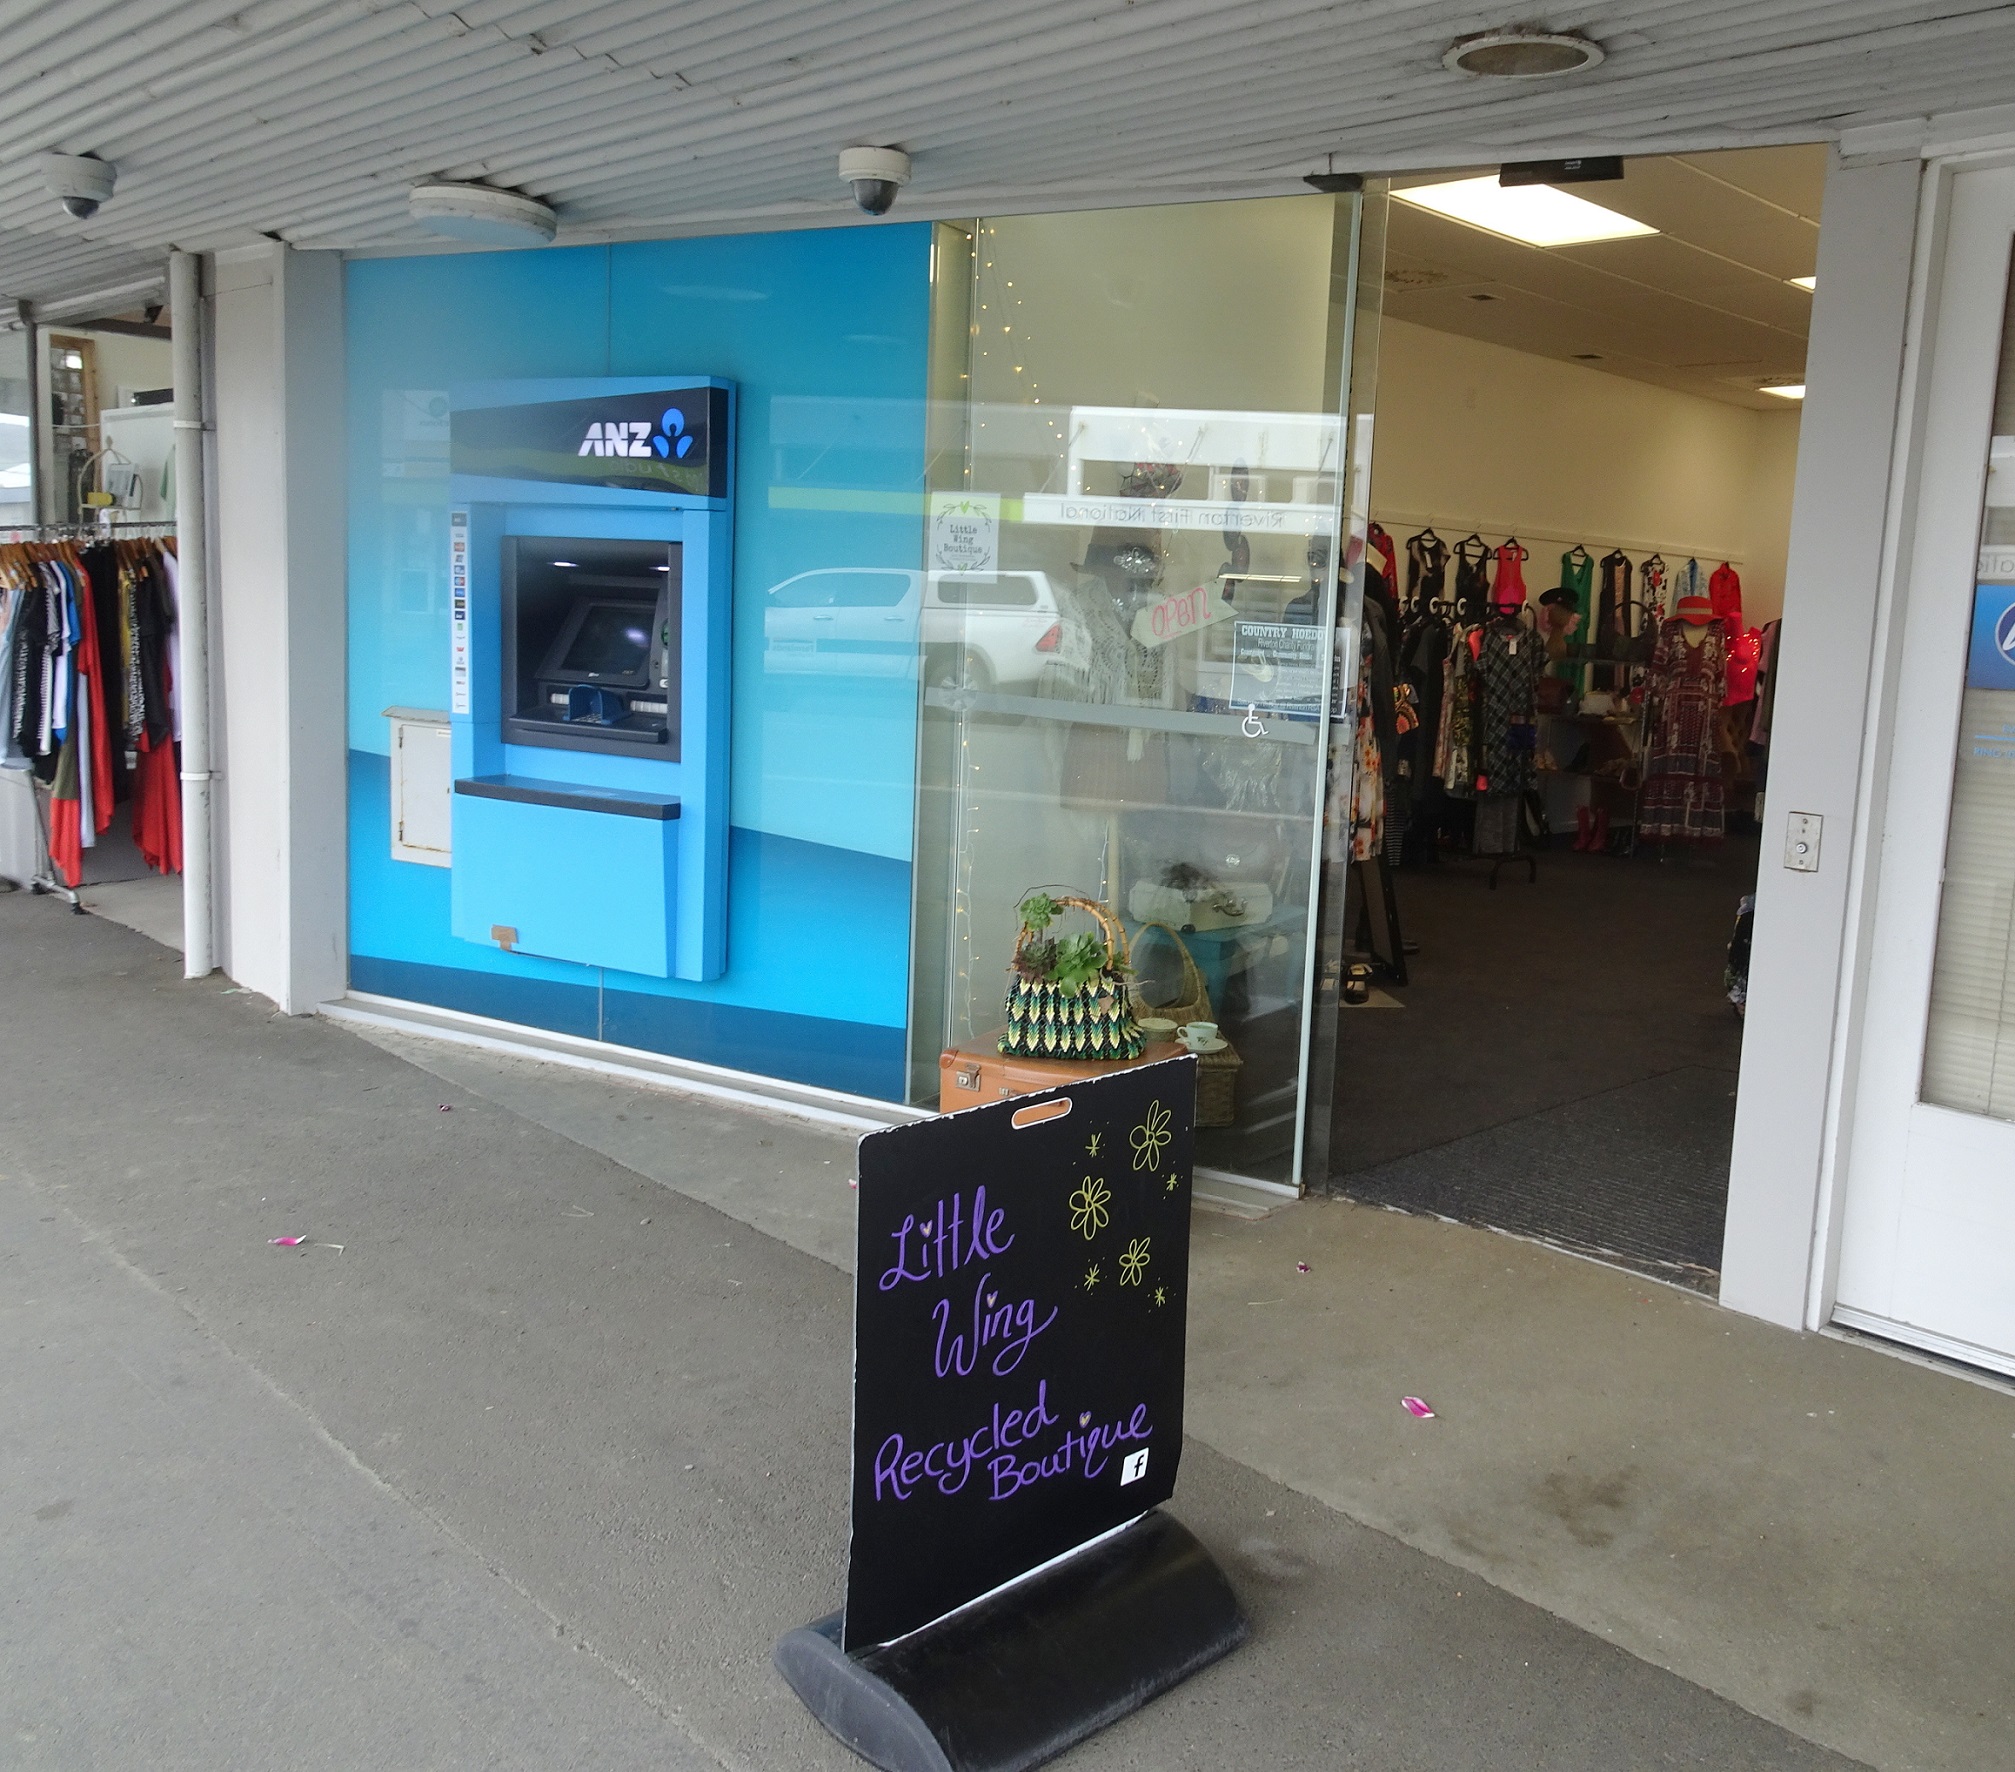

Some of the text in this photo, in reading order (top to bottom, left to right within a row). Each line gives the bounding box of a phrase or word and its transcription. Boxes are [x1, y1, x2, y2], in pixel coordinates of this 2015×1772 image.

[578, 422, 652, 457] ANZ
[950, 524, 978, 534] Little
[953, 535, 975, 545] Wing
[943, 543, 983, 555] Boutique
[1241, 625, 1326, 640] COUNTRY HOEDO
[878, 1185, 1015, 1292] Little
[931, 1272, 1058, 1378] Wing
[873, 1379, 1059, 1502] Recycled
[988, 1401, 1154, 1501] Boutique
